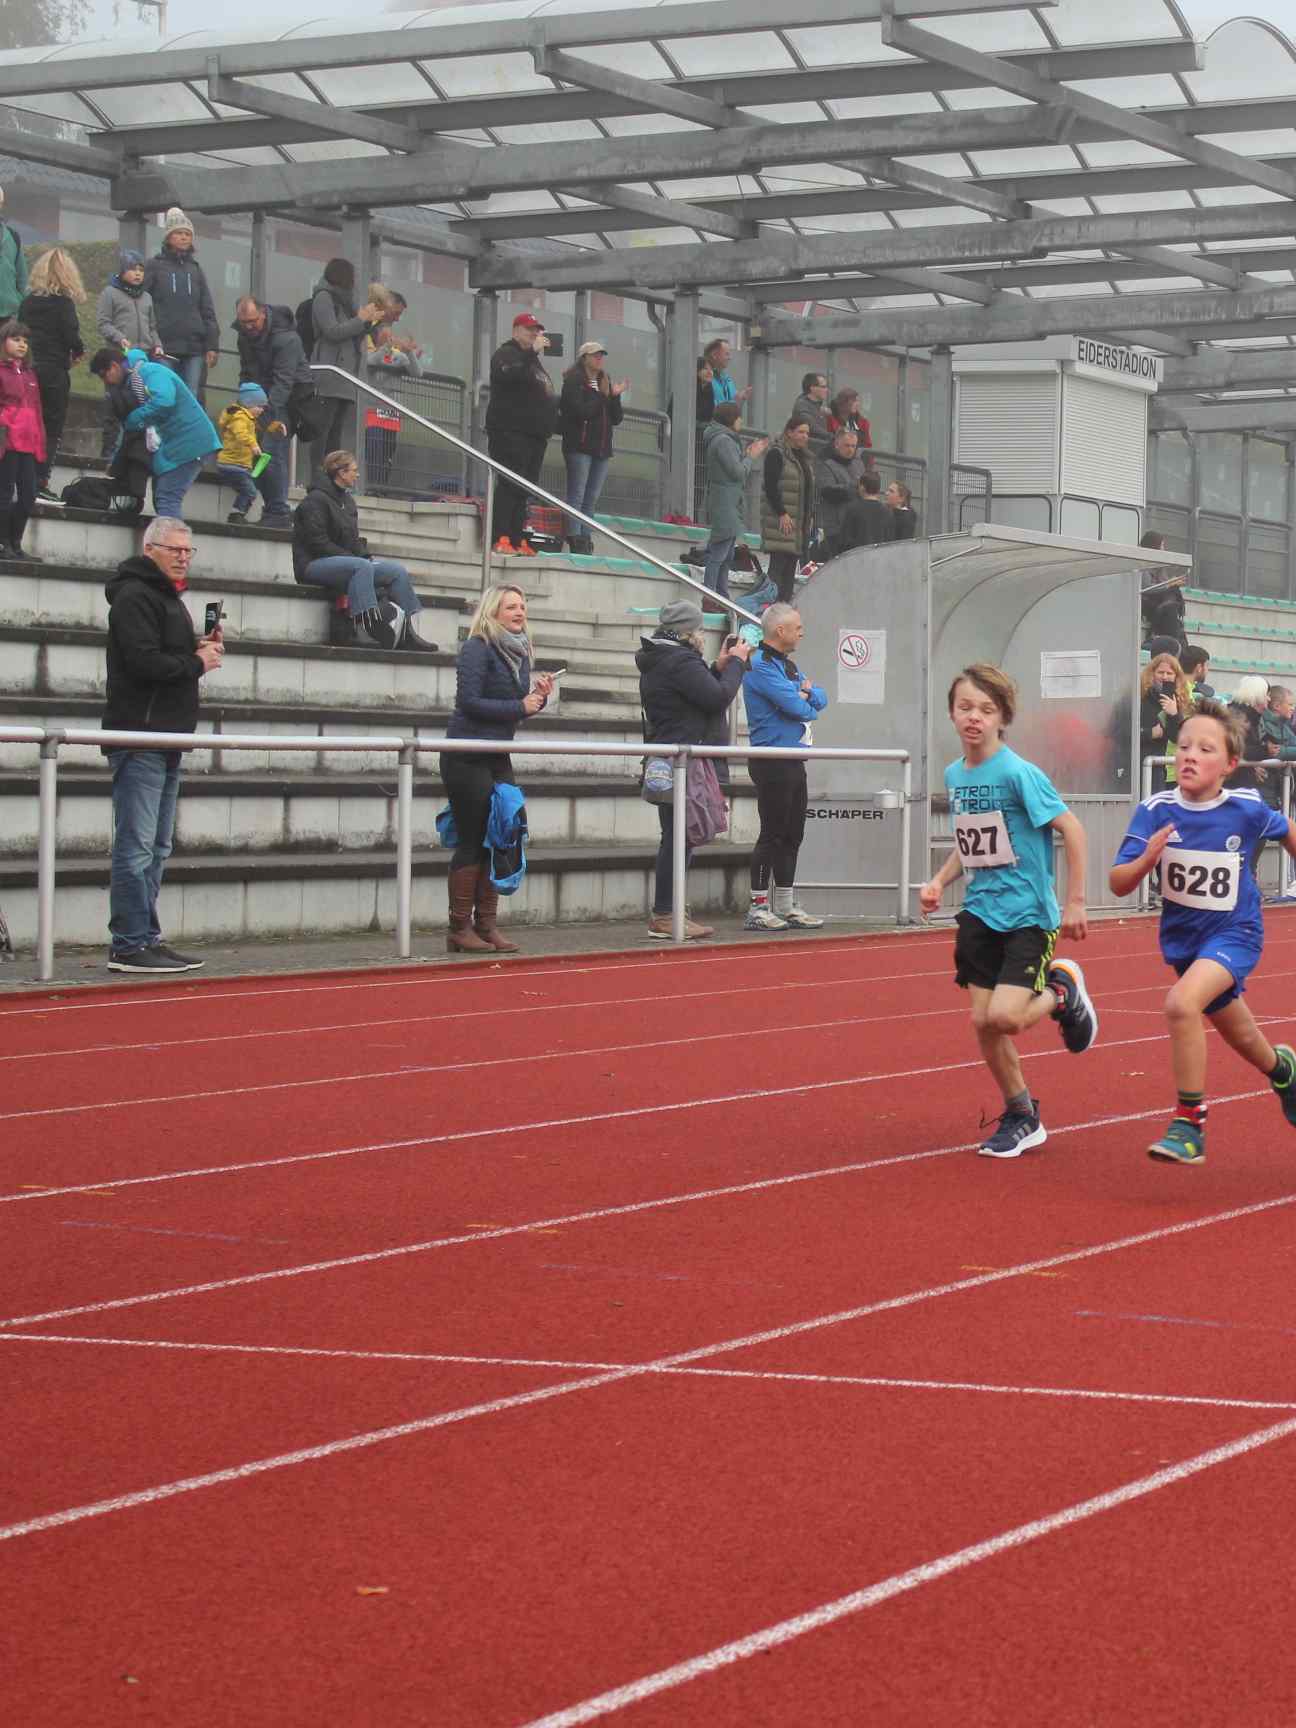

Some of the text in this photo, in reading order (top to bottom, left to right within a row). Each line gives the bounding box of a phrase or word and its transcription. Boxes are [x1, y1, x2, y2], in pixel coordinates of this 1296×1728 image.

[1078, 339, 1156, 379] EIDERSTADION
[956, 825, 998, 856] 627
[1167, 862, 1231, 899] 628
